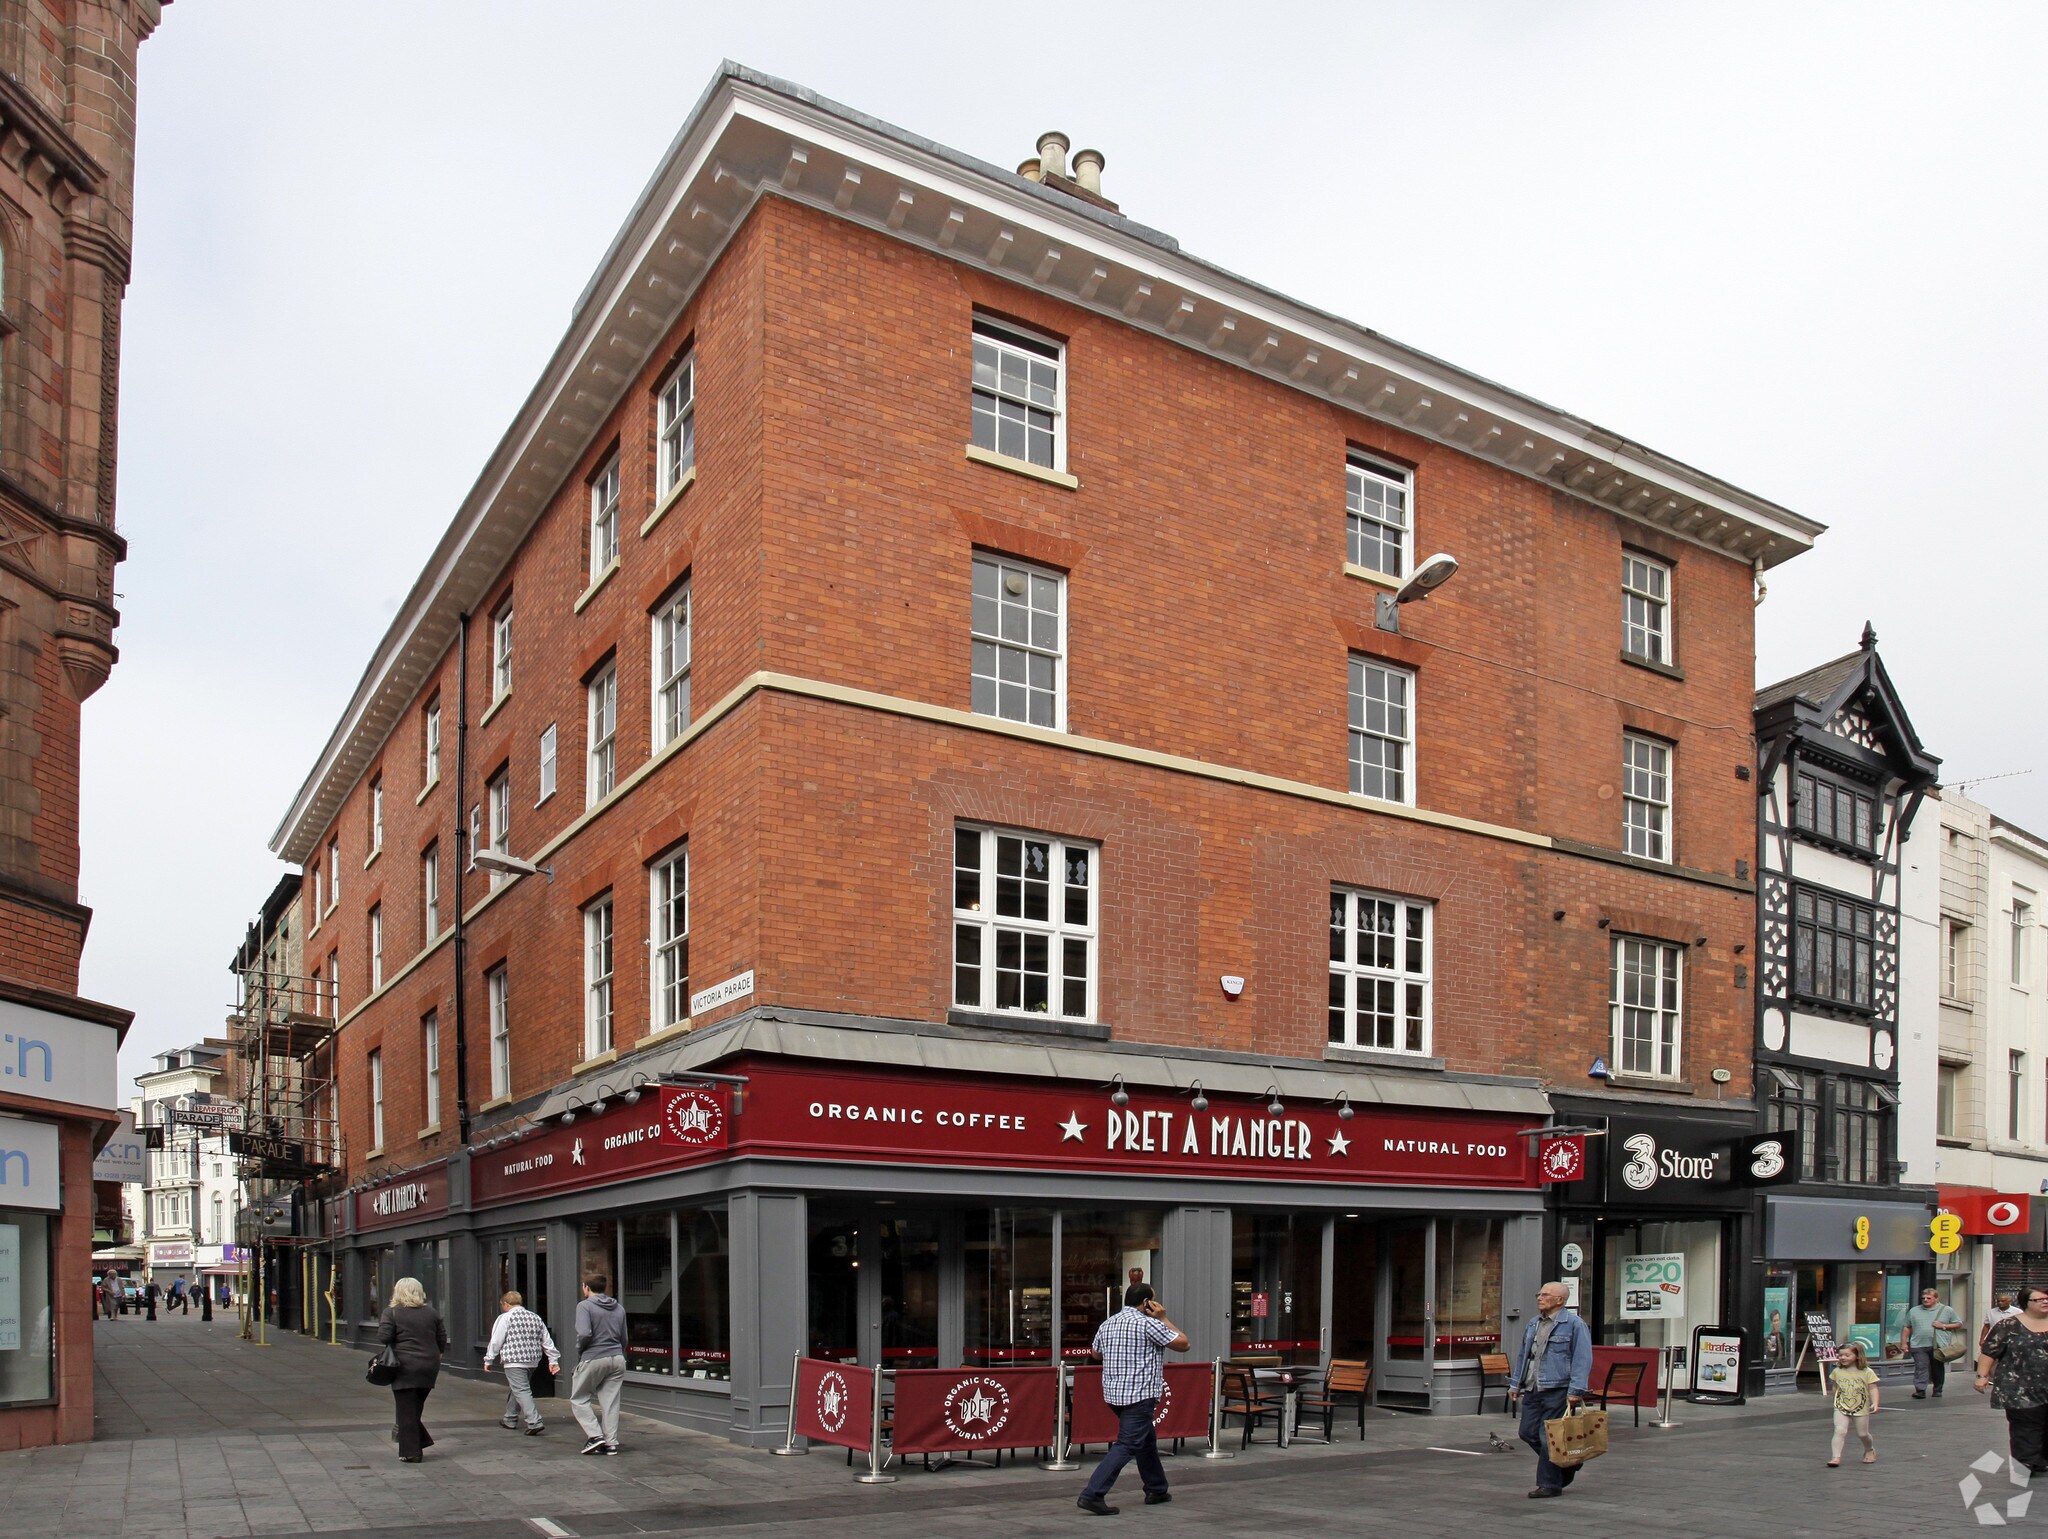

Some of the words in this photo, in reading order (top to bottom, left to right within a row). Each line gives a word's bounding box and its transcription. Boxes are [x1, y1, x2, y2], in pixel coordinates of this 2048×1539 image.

[693, 990, 722, 1010] VICTORIA
[724, 977, 751, 998] PARADE
[667, 1092, 695, 1114] ORGANIC
[698, 1093, 723, 1118] COFFEE
[809, 1102, 924, 1124] ORGANIC
[935, 1111, 1027, 1131] COFFEE
[176, 1112, 220, 1123] PARADE
[680, 1108, 709, 1129] PRET
[604, 1128, 645, 1150] ORGANIC
[668, 1123, 702, 1144] NATURAL
[704, 1126, 721, 1142] FOOD
[1107, 1108, 1174, 1153] PRET
[1182, 1114, 1200, 1155] A
[1211, 1116, 1312, 1160] MANGER
[242, 1137, 293, 1161] PARADE
[1383, 1138, 1460, 1156] NATURAL
[1467, 1143, 1508, 1158] FOOD
[1750, 1140, 1785, 1179] 3
[504, 1160, 533, 1176] NATURAL
[535, 1154, 553, 1169] FOOD
[1622, 1133, 1659, 1191] 3
[1625, 1261, 1682, 1284] £20
[818, 1370, 835, 1396] ORGANIC
[835, 1372, 848, 1401] COFFEE
[944, 1376, 980, 1407] ORGANIC
[983, 1377, 1010, 1405] COFFEE
[817, 1407, 835, 1433] NATURAL
[835, 1413, 846, 1431] FOOD
[961, 1398, 995, 1420] PRET
[1152, 1408, 1169, 1427] FOOD
[945, 1418, 984, 1440] NATURAL
[986, 1416, 1007, 1437] FOOD
